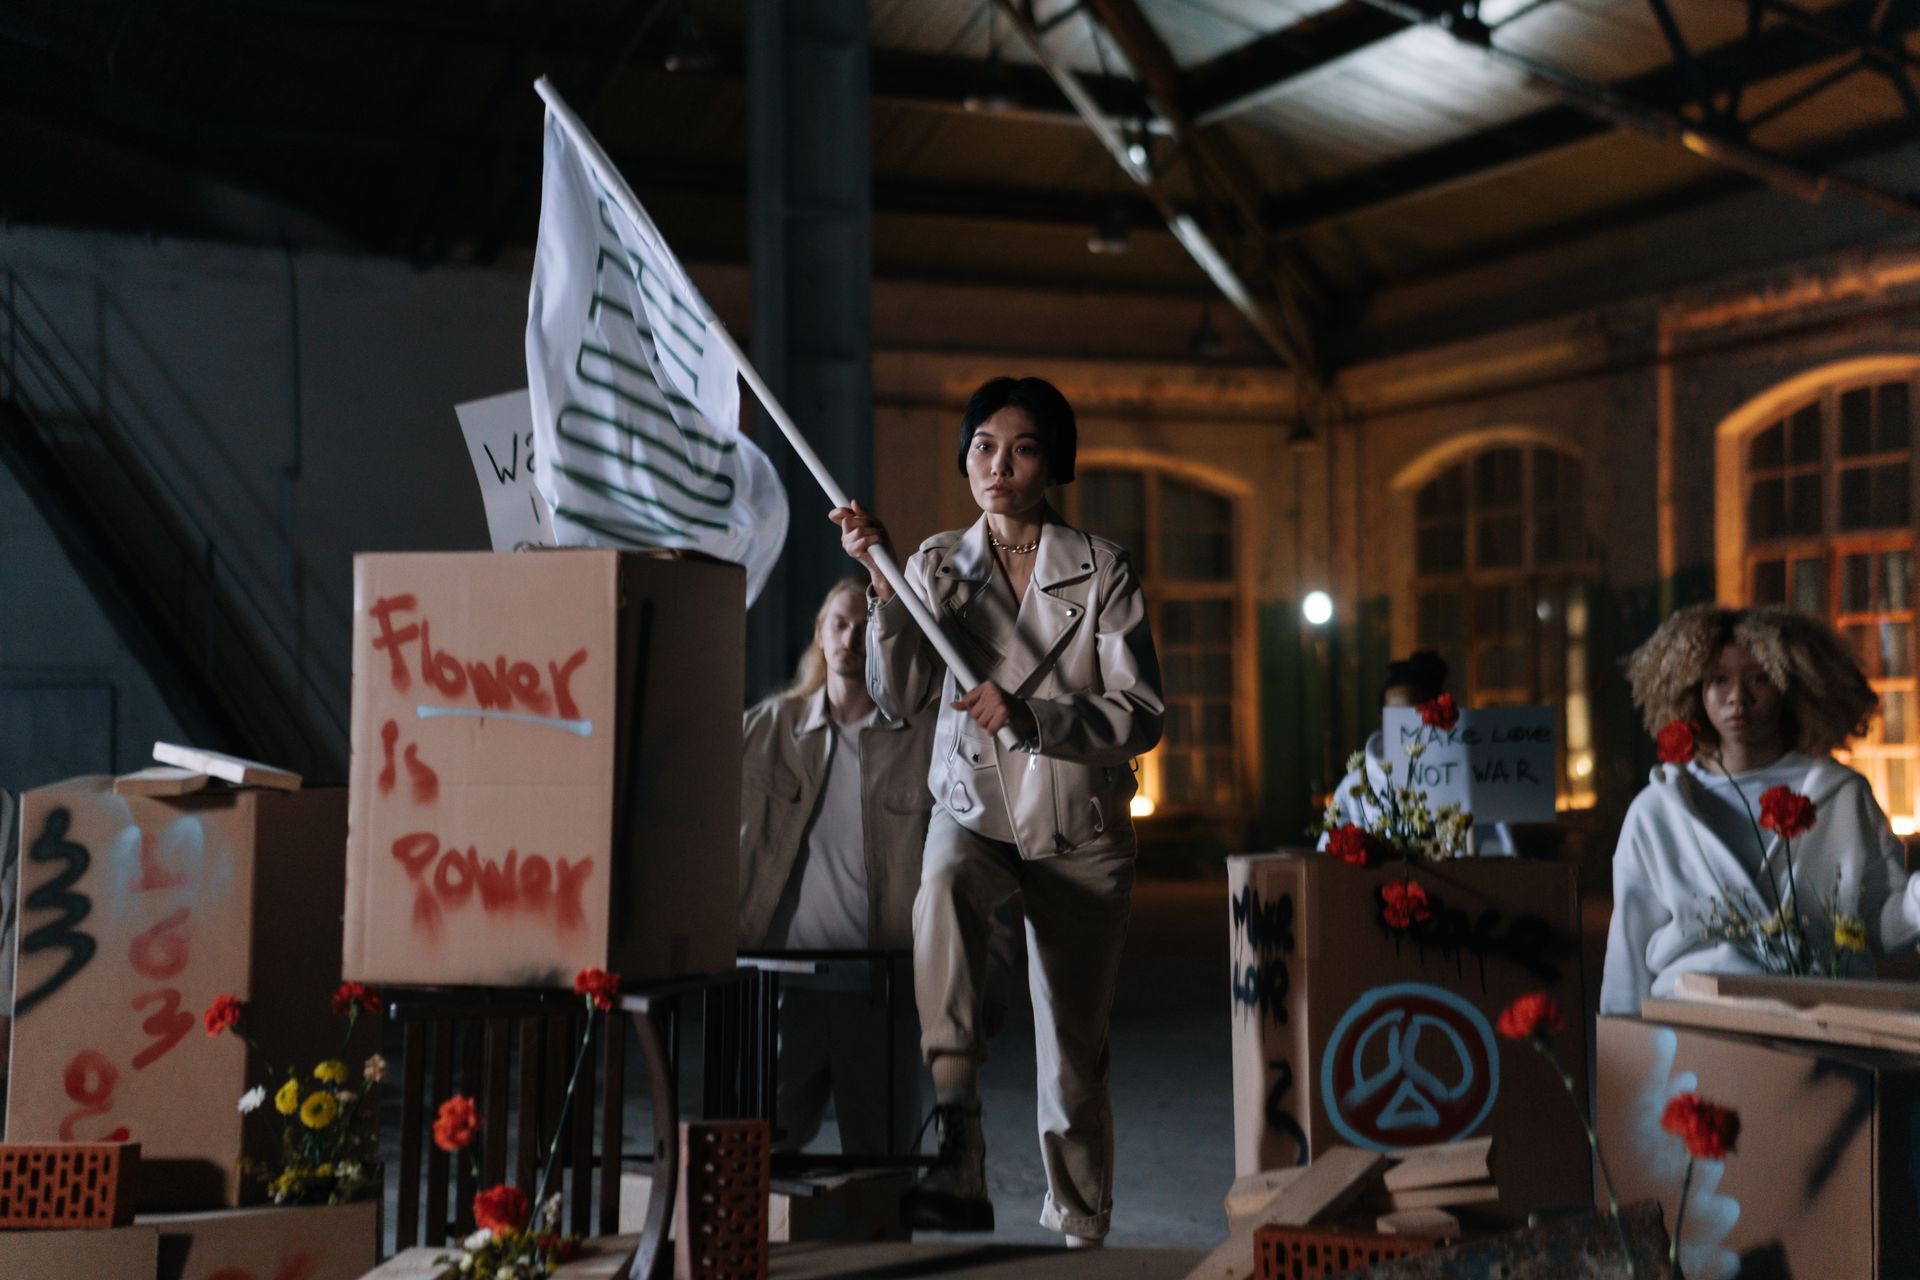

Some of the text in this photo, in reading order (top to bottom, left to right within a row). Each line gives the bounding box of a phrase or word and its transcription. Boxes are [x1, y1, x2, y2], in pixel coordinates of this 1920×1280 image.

[369, 594, 588, 720] Flower
[1408, 758, 1539, 788] NOT WAR
